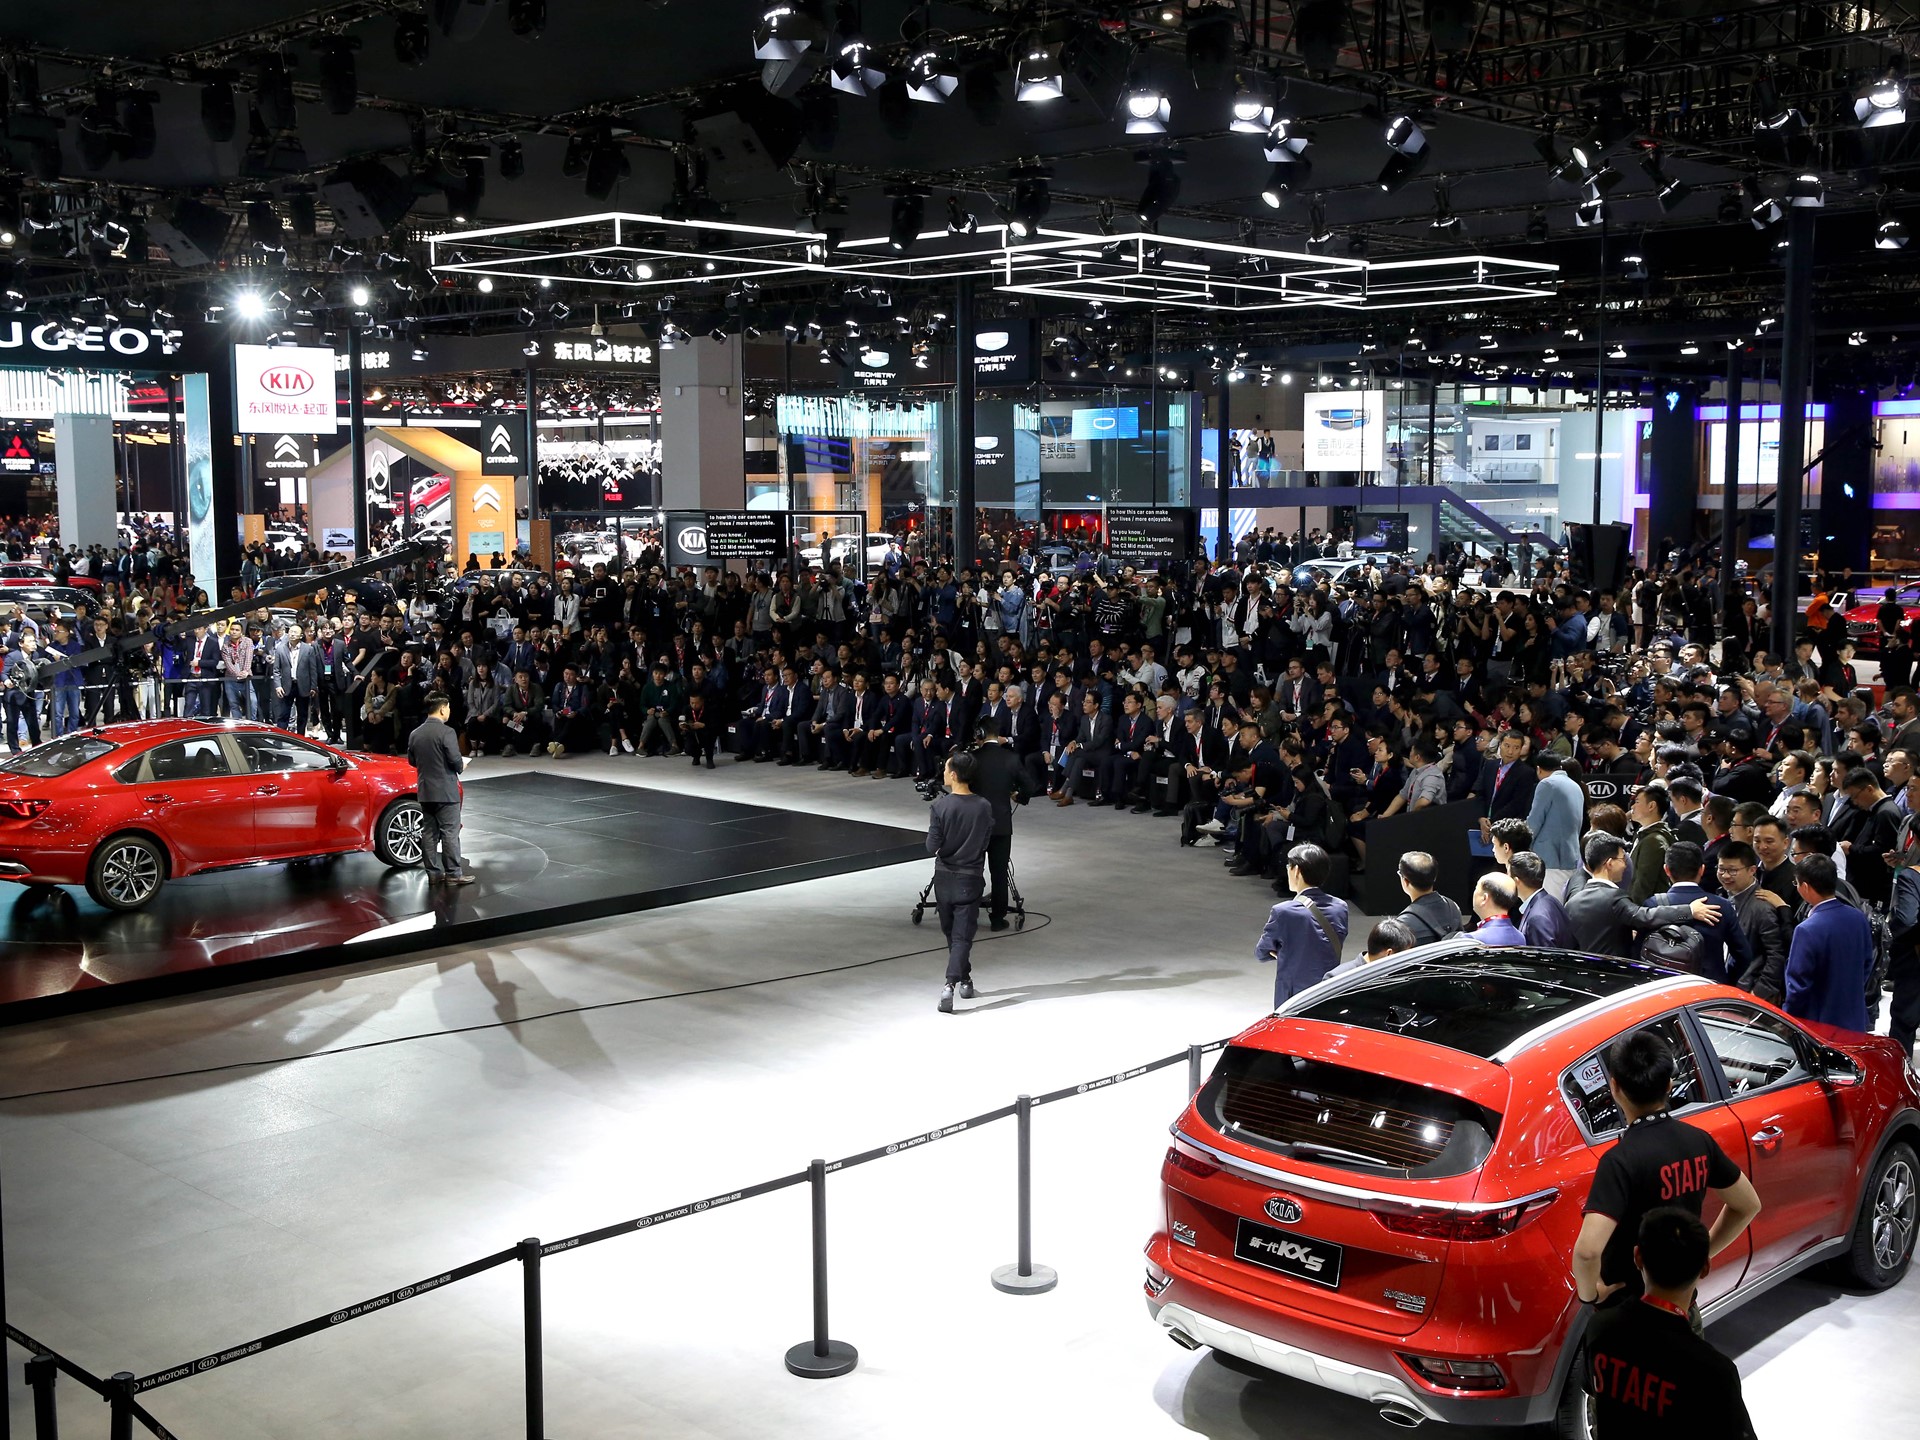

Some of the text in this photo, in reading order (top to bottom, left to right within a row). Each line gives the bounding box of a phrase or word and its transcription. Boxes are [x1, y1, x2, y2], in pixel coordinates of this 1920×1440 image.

[974, 355, 1016, 364] EOMETRY
[270, 373, 305, 389] KIA
[683, 533, 707, 548] KIA
[1588, 784, 1611, 795] KIA
[908, 1136, 926, 1147] MOTORS
[1660, 1155, 1708, 1200] STAFF
[654, 1214, 664, 1222] KIA
[665, 1208, 688, 1219] MOTORS
[1269, 1200, 1295, 1220] KIA
[351, 1307, 362, 1316] KIA
[363, 1296, 389, 1312] MOTORS
[142, 1380, 156, 1388] KIA
[157, 1366, 189, 1383] MOTORS
[1594, 1353, 1677, 1417] STAFF
